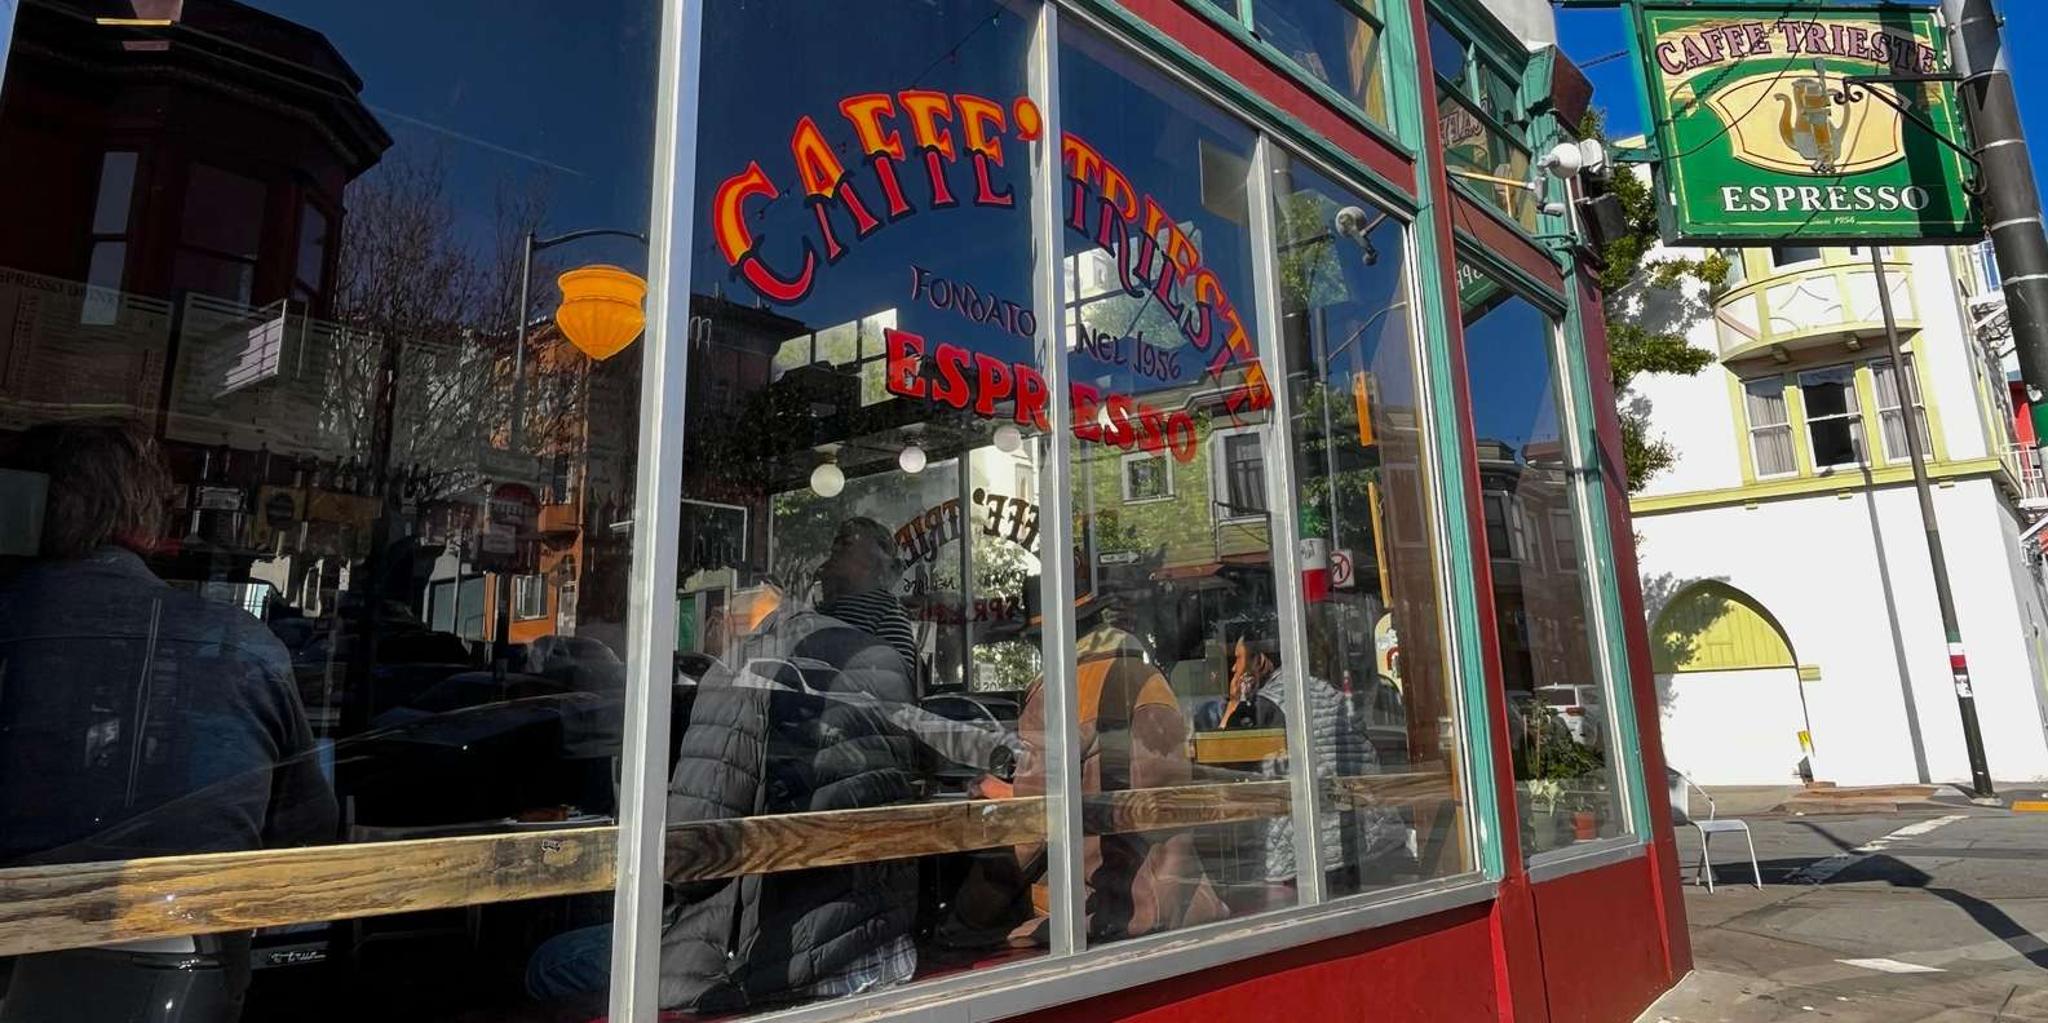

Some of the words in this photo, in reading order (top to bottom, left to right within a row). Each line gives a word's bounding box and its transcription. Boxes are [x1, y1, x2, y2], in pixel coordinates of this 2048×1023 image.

[1655, 21, 1773, 76] CAFFE
[1777, 20, 1938, 75] TRIESTE
[1720, 184, 1930, 213] ESPRESSO
[712, 89, 1043, 305] CAFFE'
[1060, 130, 1273, 430] TRIESTE
[910, 263, 1037, 338] FONDATO
[1132, 330, 1181, 382] 1956
[884, 327, 1197, 464] ESPRESSO
